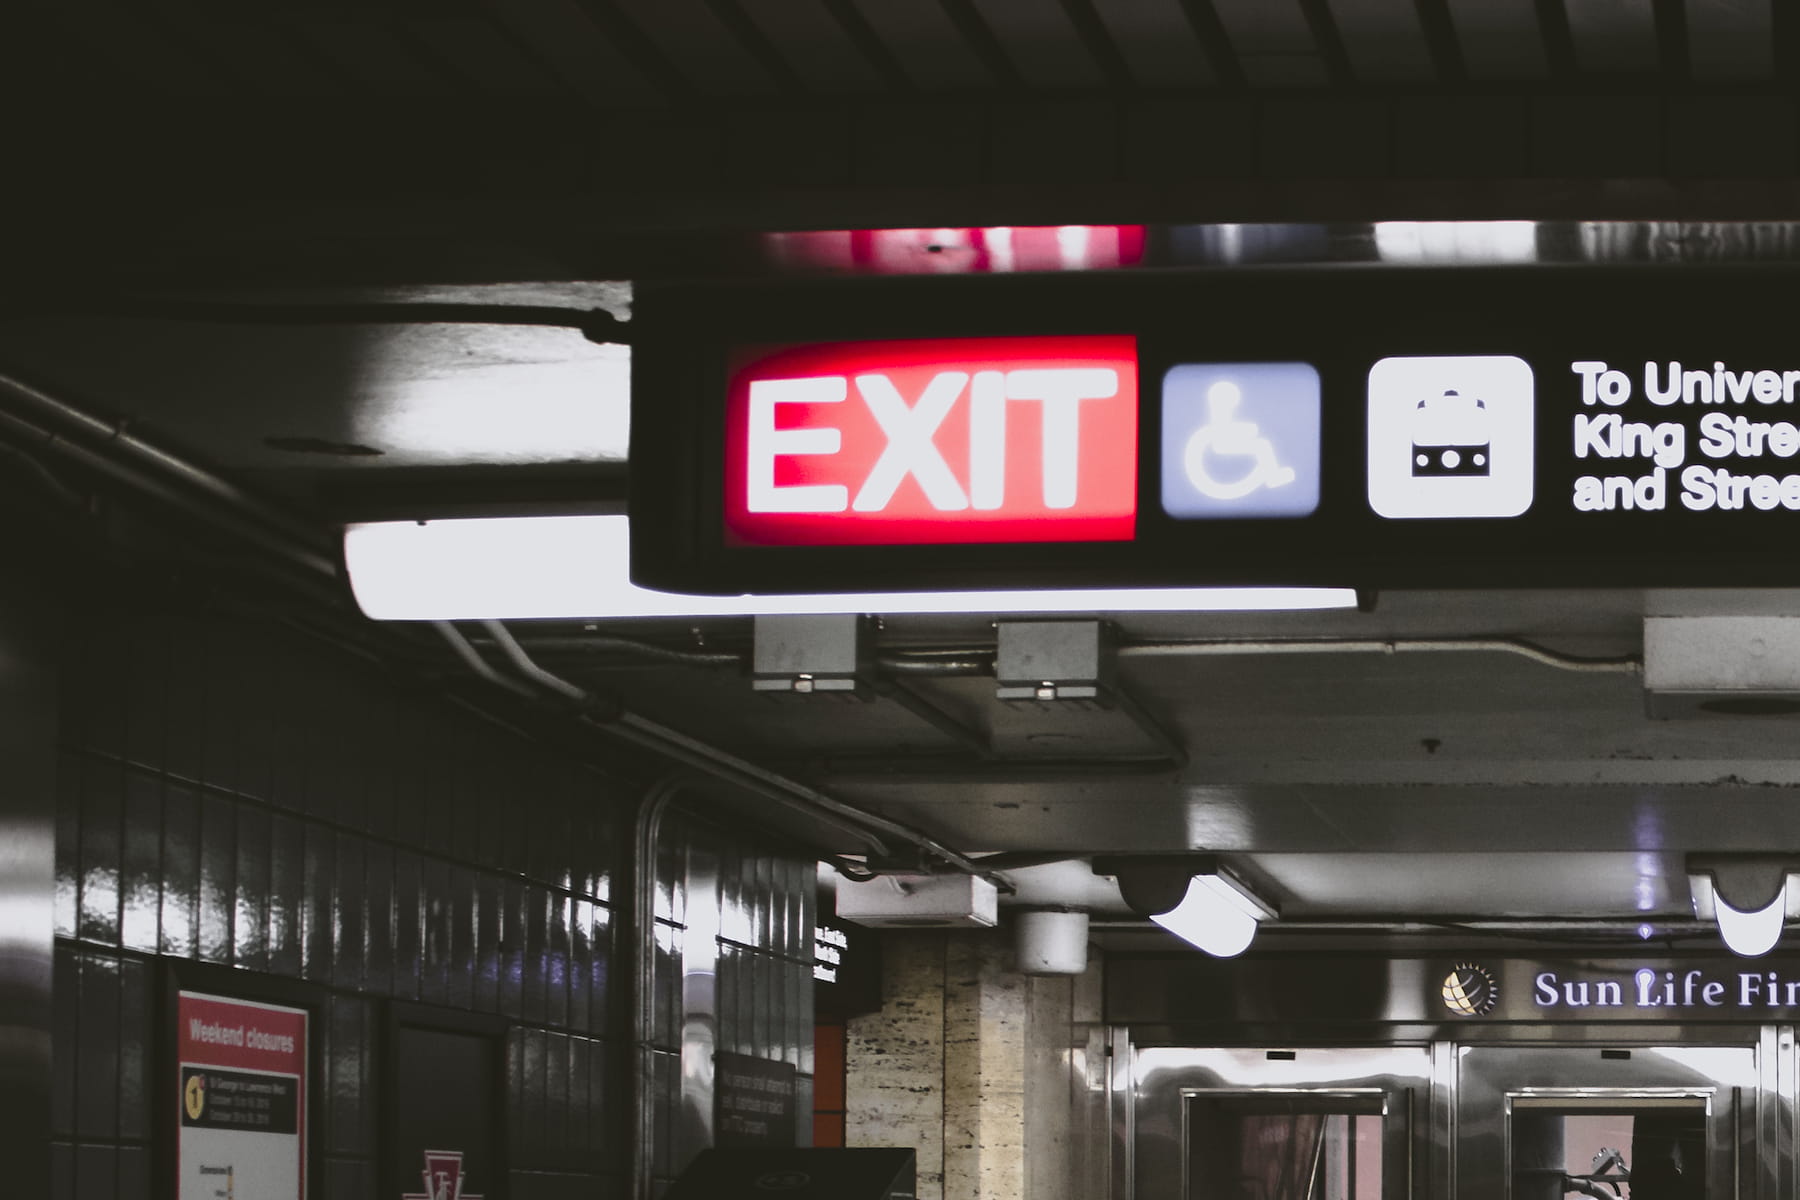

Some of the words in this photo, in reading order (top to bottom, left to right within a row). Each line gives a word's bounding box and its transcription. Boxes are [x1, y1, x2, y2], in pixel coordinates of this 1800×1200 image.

[1572, 361, 1631, 405] To
[747, 368, 1118, 513] EXIT
[1573, 413, 1686, 468] King
[1573, 465, 1666, 510] and
[1535, 971, 1622, 1007] Sun
[1636, 968, 1726, 1007] Life
[189, 1017, 244, 1047] Weekend
[247, 1027, 294, 1054] closures
[192, 1087, 198, 1108] 1
